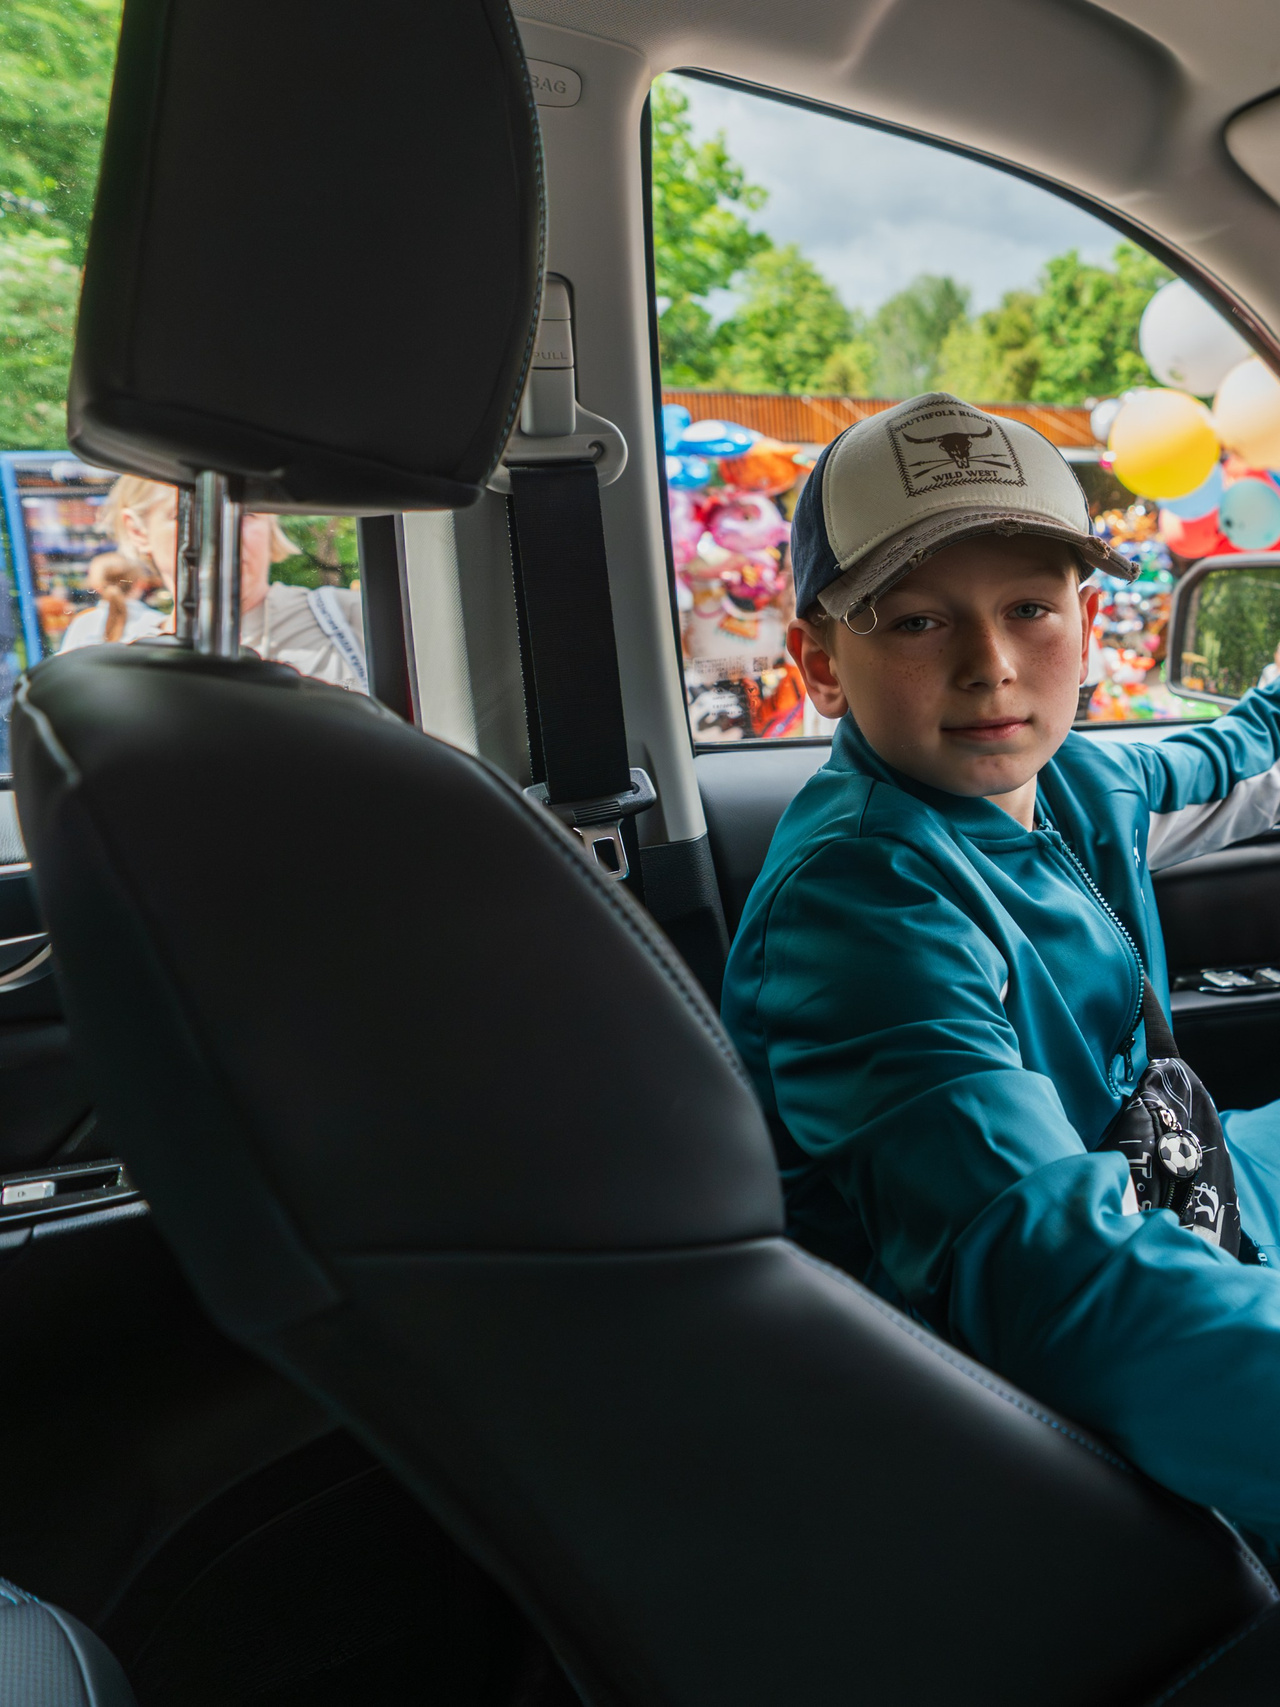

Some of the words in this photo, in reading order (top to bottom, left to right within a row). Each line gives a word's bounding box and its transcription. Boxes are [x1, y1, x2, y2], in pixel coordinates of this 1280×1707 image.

[894, 410, 956, 433] SOUTHFOLK
[931, 472, 963, 482] WILD
[965, 470, 999, 478] WEST
